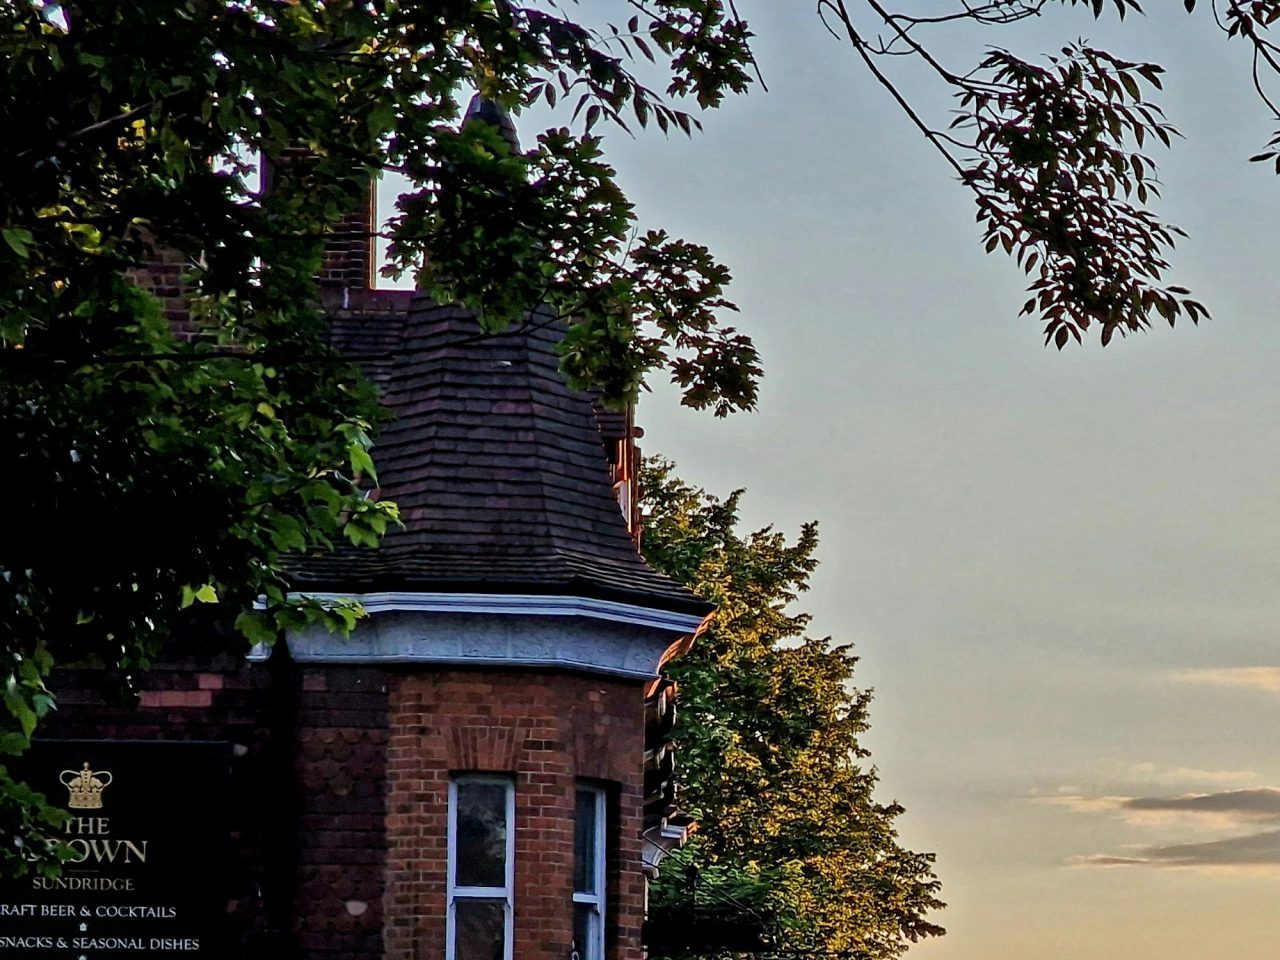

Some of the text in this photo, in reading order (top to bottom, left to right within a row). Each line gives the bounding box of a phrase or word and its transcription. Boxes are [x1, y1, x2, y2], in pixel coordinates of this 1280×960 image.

[65, 817, 110, 834] THE
[32, 877, 135, 890] SUNDRIDGE
[0, 904, 177, 918] RAFT BEER & COCKTAILS
[0, 936, 200, 950] SNACKS & SEASONAL DISHES
